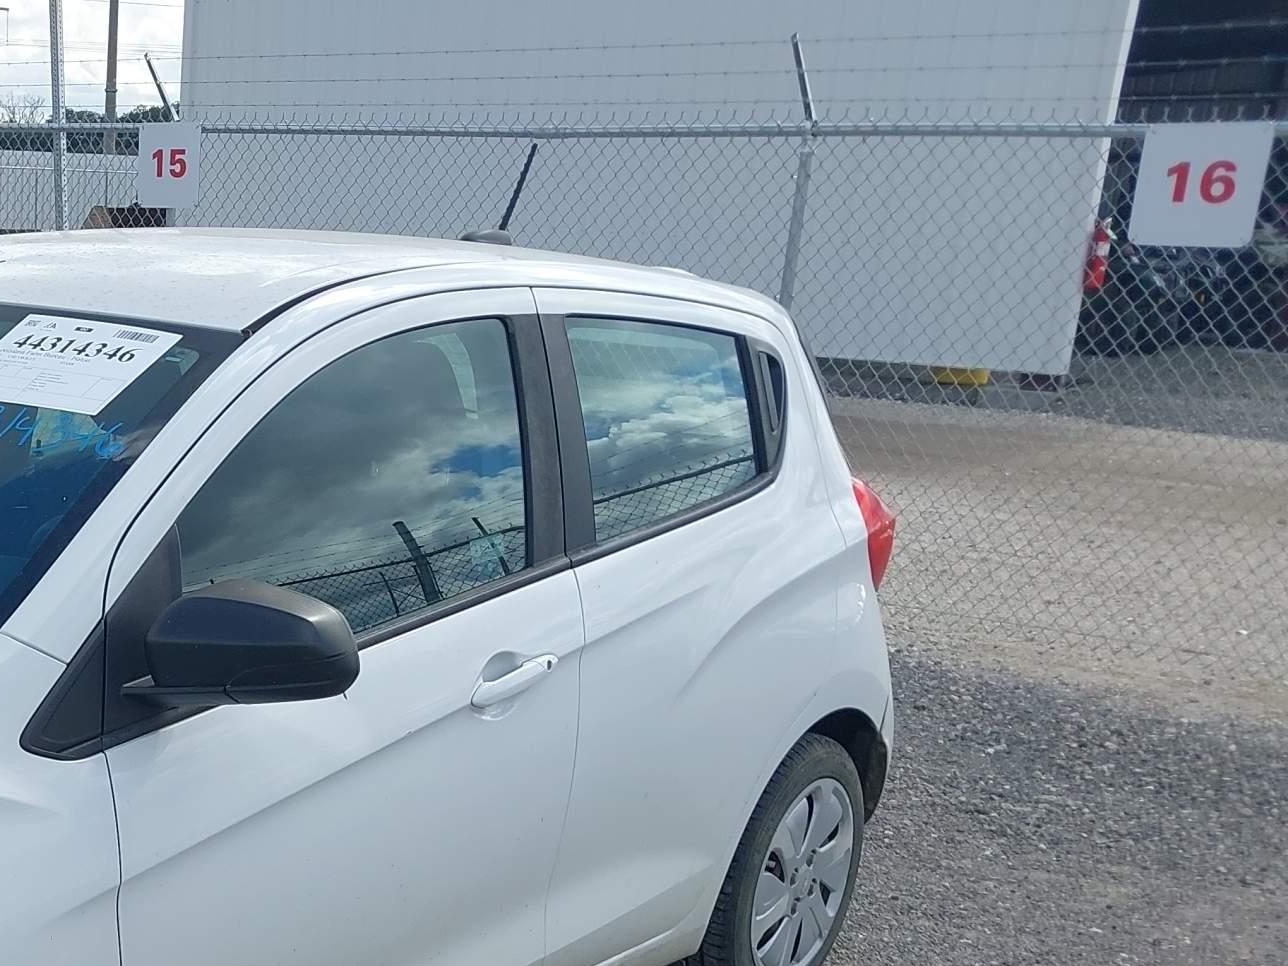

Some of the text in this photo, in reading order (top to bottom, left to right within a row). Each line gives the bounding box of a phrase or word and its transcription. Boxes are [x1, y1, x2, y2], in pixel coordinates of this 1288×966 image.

[152, 148, 187, 178] 15
[1167, 160, 1237, 204] 16
[13, 333, 144, 363] 44314346
